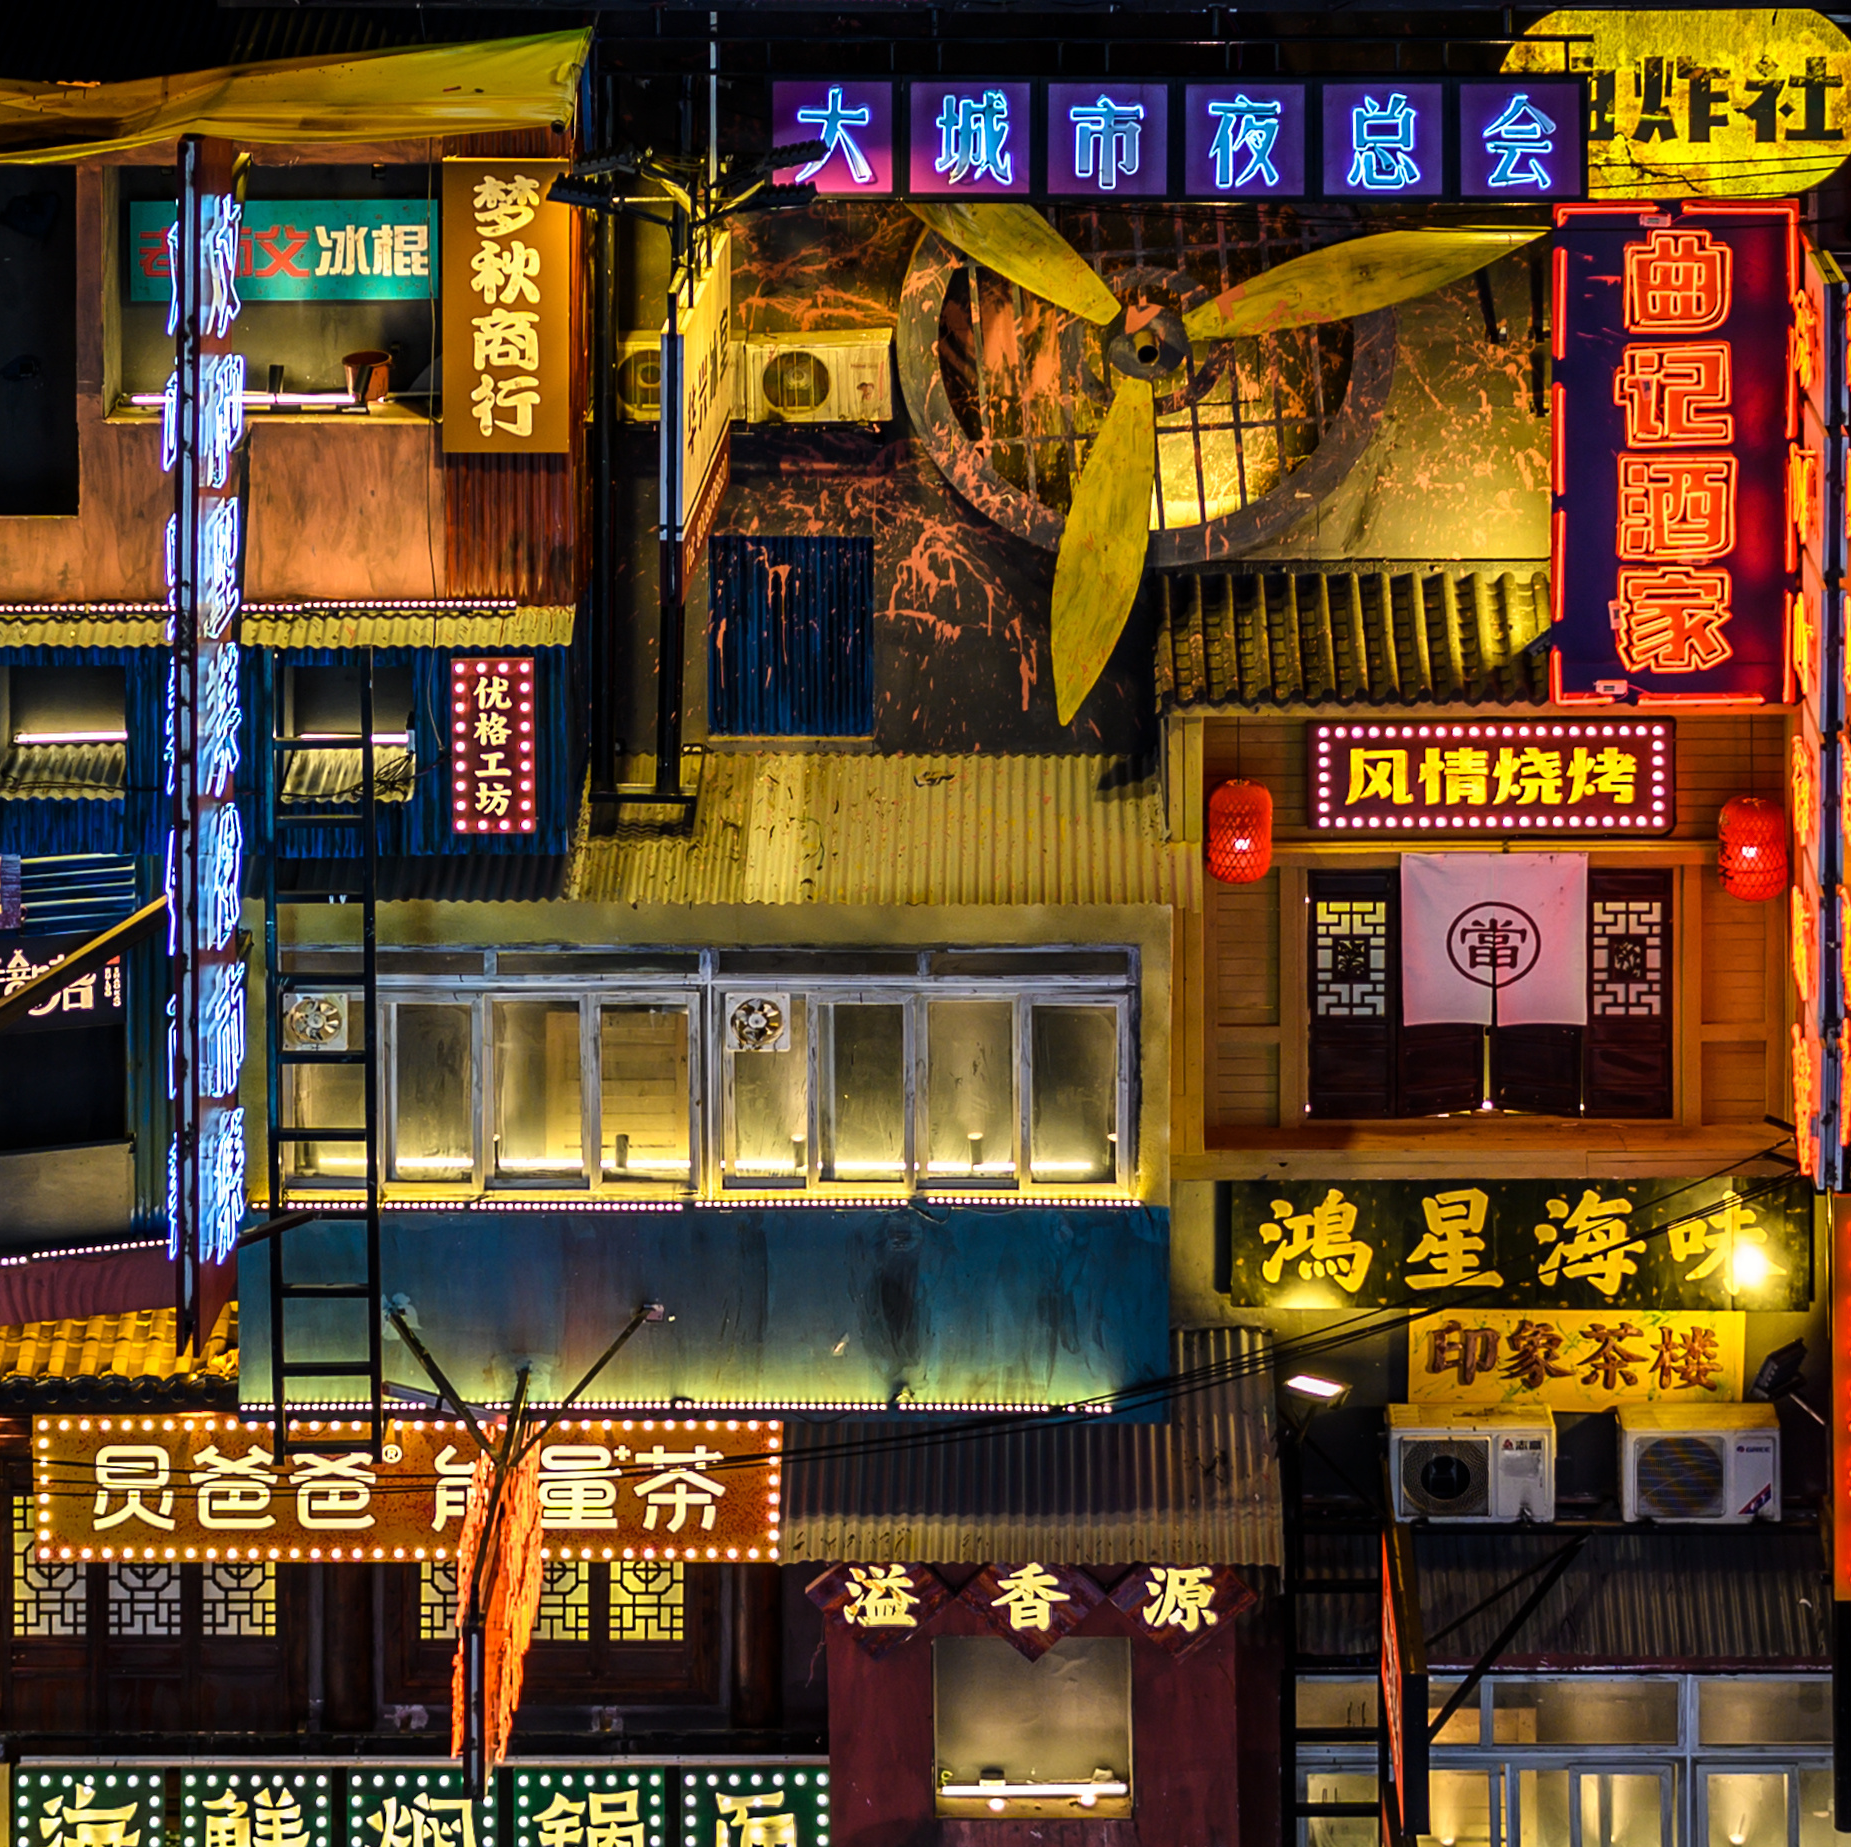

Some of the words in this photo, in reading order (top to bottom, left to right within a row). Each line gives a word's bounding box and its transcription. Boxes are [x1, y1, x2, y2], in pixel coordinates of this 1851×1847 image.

[796, 86, 1556, 190] 大城市夜总会
[1588, 55, 1845, 143] 炸社
[470, 175, 542, 438] 梦秋商行
[1614, 228, 1737, 675] 曲记酒家
[474, 675, 513, 817] 优格工坊
[1345, 747, 1638, 806] 风情烧烤
[1459, 917, 1528, 970] 當
[1425, 1320, 1723, 1393] 印象茶楼
[843, 1561, 1220, 1634] 溢香源
